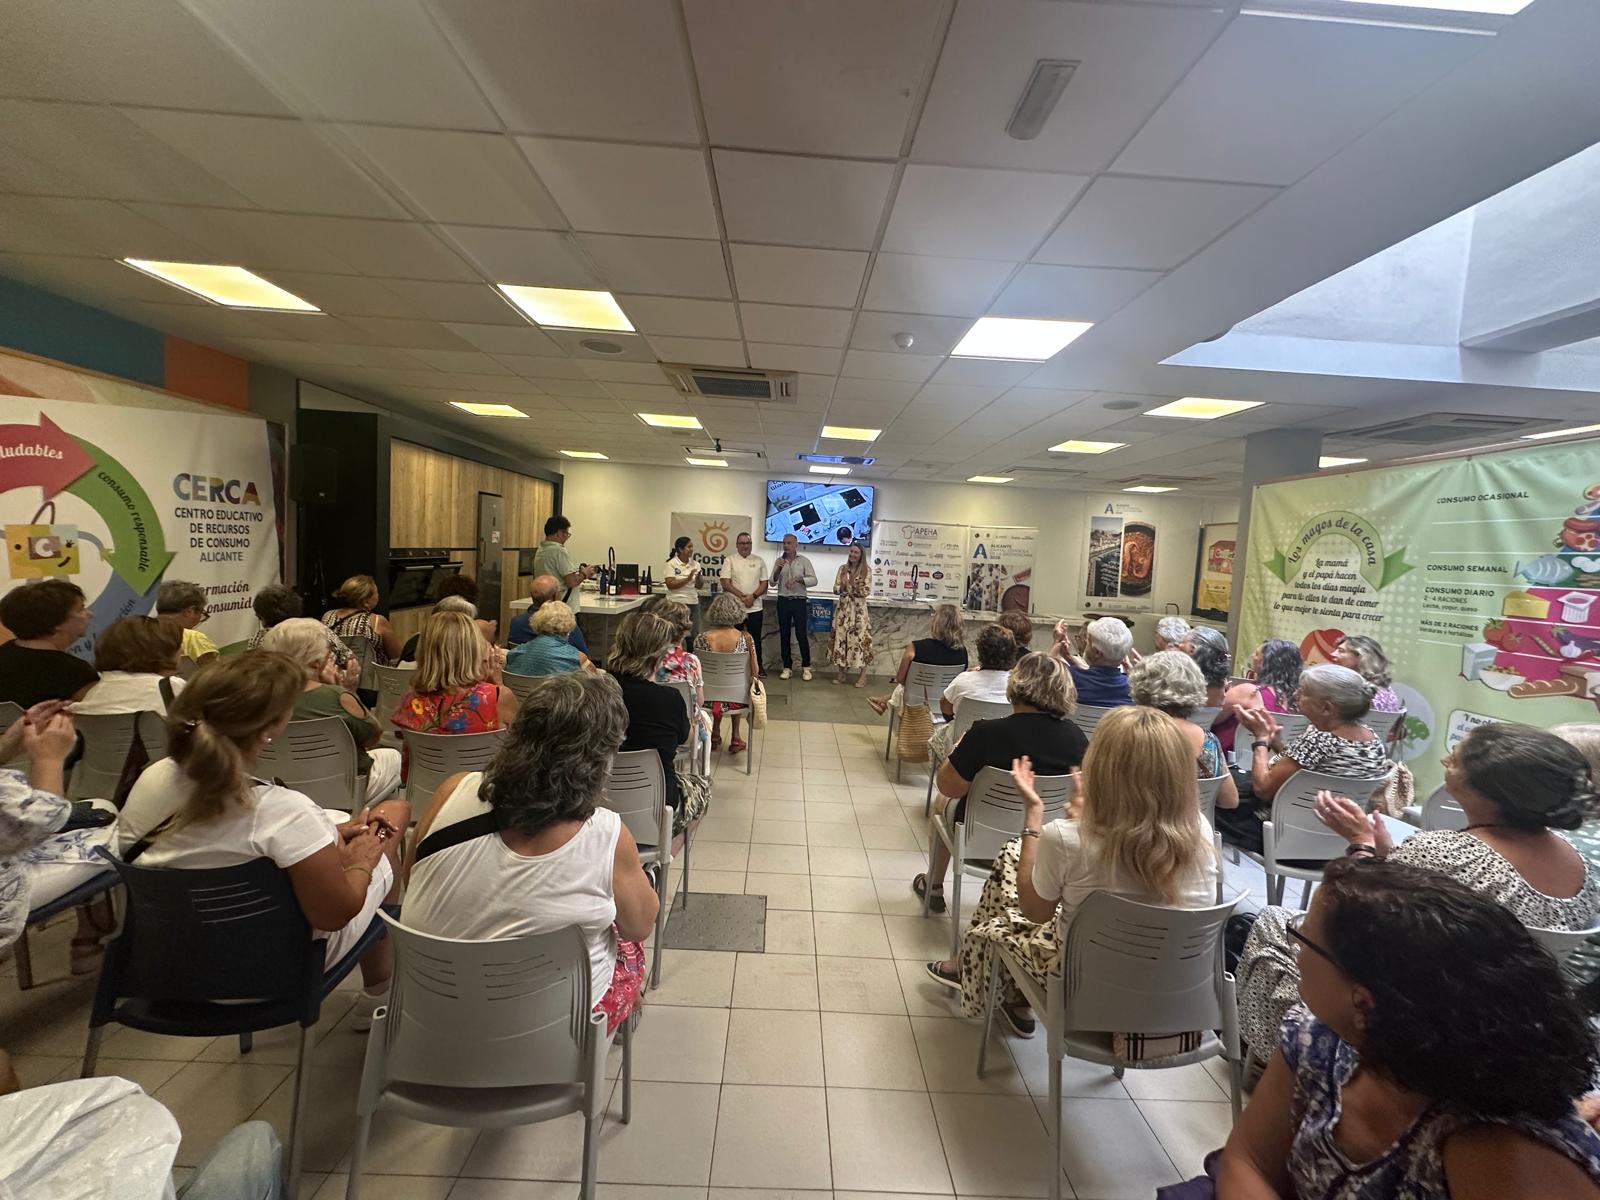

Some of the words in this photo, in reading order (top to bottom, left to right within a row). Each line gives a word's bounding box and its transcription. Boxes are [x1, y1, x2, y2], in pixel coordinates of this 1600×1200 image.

[173, 472, 261, 506] CERCA
[1436, 495, 1476, 504] CONSUMO
[1477, 491, 1529, 501] OCASIONAL
[175, 507, 214, 519] CENTRO
[216, 509, 263, 522] EDUCATIVO
[98, 471, 136, 511] consumo
[131, 511, 150, 573] responsable
[190, 523, 203, 534] DE
[206, 523, 250, 535] RECURSOS
[915, 527, 938, 536] APEHA
[190, 537, 203, 548] DE
[206, 537, 250, 548] CONSUMO
[1287, 546, 1303, 564] Los
[1302, 519, 1333, 545] magos
[1335, 517, 1350, 529] de
[1350, 522, 1364, 537] la
[1361, 536, 1377, 567] casa
[200, 551, 244, 562] ALICANTE
[693, 552, 726, 565] Cost
[1324, 559, 1349, 567] mamá
[1335, 570, 1357, 580] hacen
[1426, 564, 1465, 572] CONSUMO
[1466, 565, 1508, 573] SEMANAL
[199, 580, 249, 596] ormación
[1294, 581, 1311, 590] todos
[1311, 582, 1321, 590] los
[1339, 584, 1366, 595] magia
[1425, 587, 1463, 595] CONSUMO
[1464, 588, 1495, 597] DIARIO
[207, 597, 254, 614] onsumid
[1281, 592, 1297, 601] para
[1321, 595, 1328, 603] te
[1328, 595, 1344, 605] dan
[1345, 596, 1355, 606] de
[1355, 599, 1380, 608] comer
[1281, 604, 1293, 612] que
[1294, 605, 1312, 615] mejor
[1312, 606, 1319, 614] te
[1319, 608, 1341, 617] sienta
[1341, 611, 1361, 620] para
[1361, 613, 1384, 622] crecer
[1448, 622, 1479, 631] RACIONES
